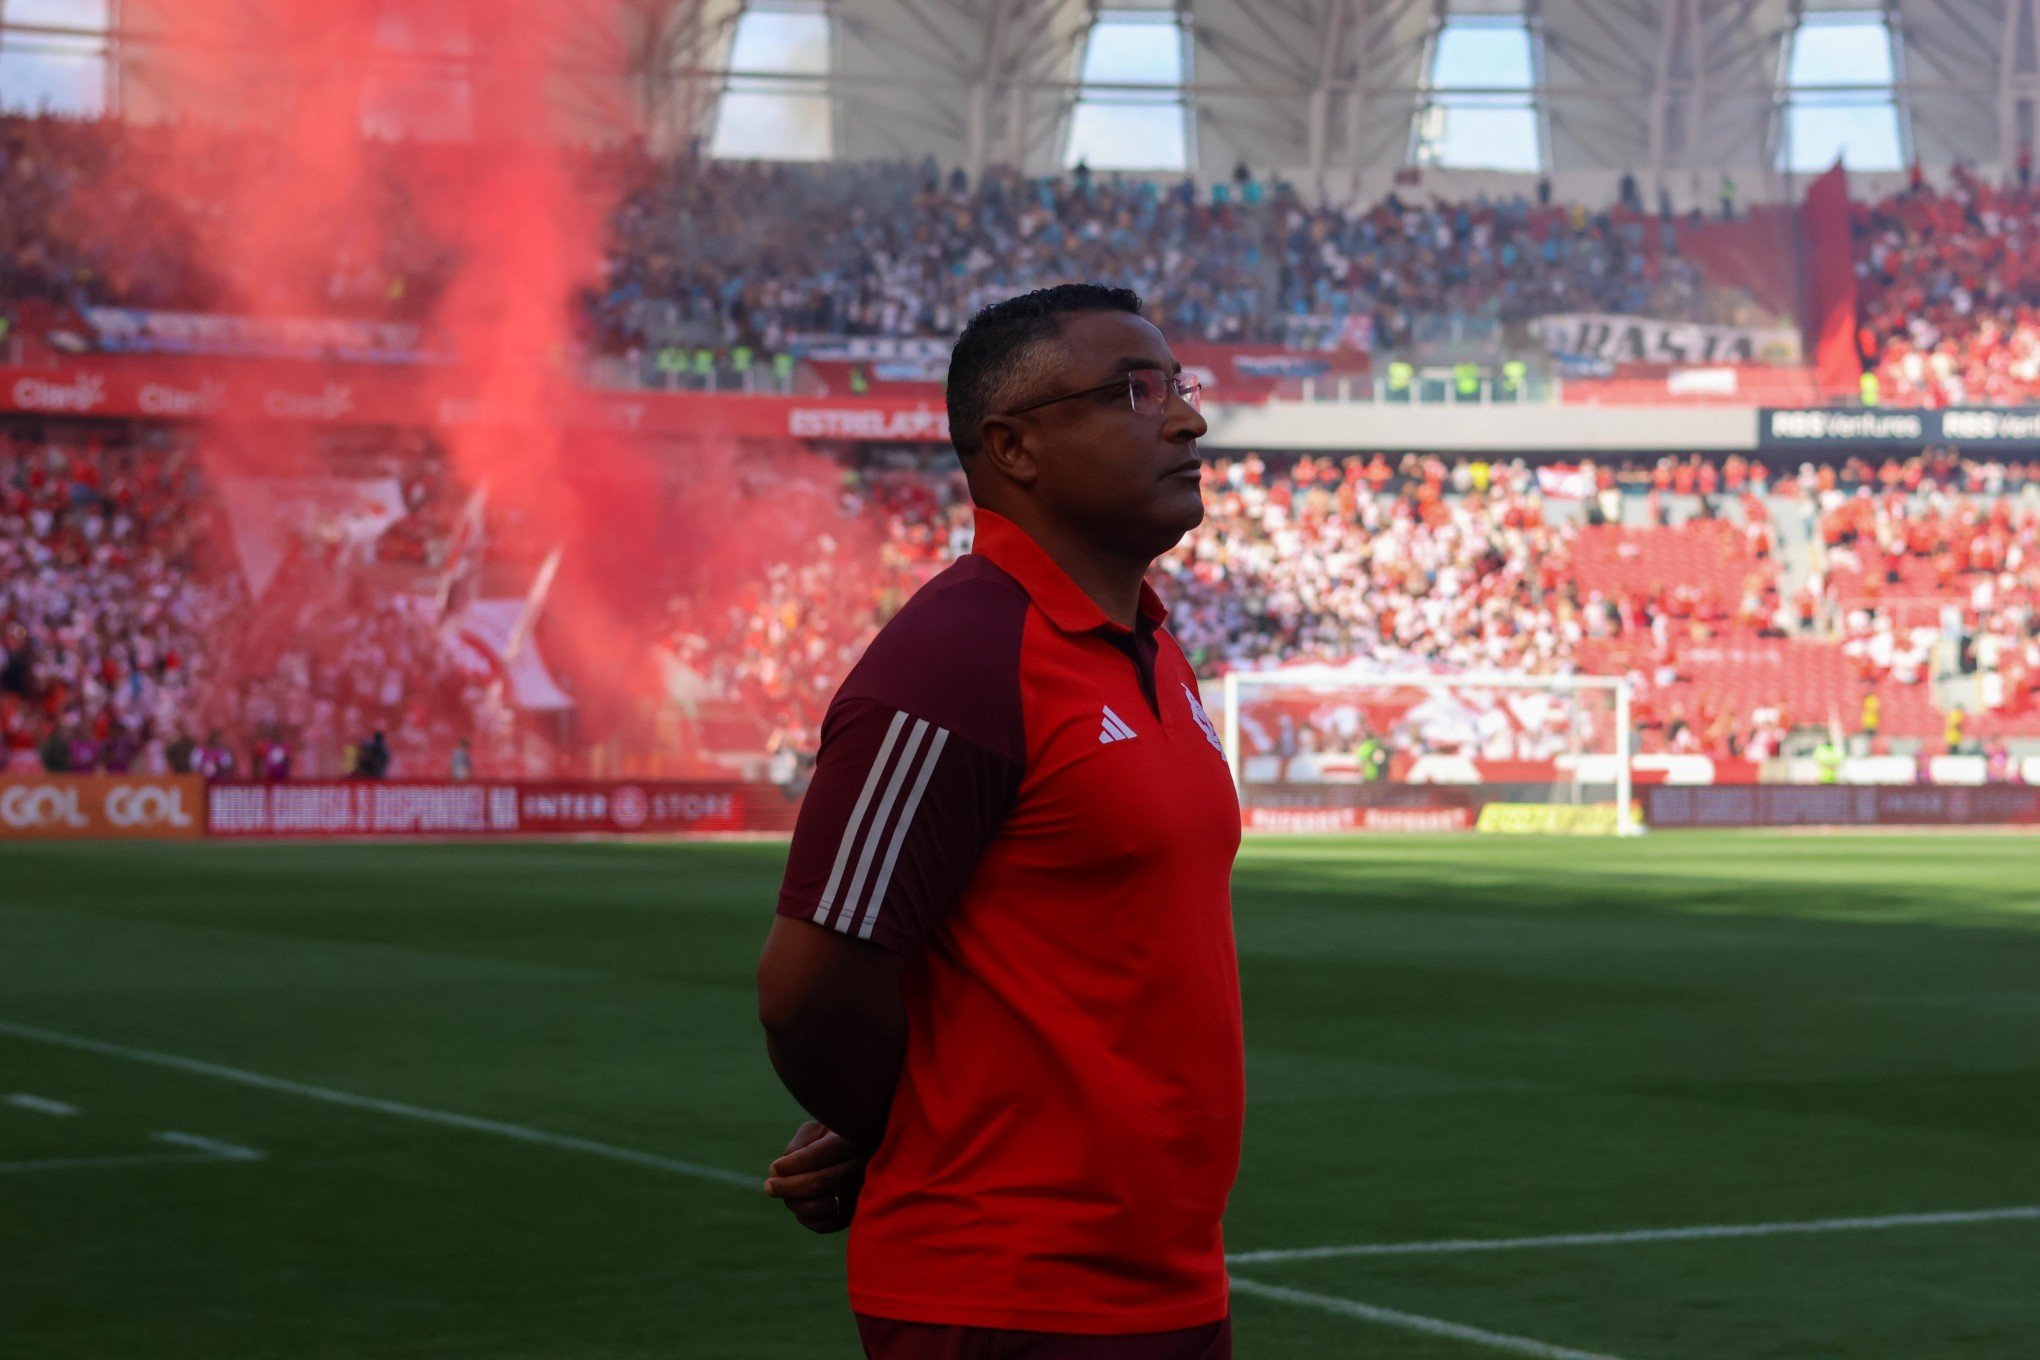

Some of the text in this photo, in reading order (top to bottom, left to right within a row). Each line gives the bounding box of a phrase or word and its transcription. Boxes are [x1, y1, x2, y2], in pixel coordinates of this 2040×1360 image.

[13, 379, 94, 411] Claro
[1, 786, 89, 828] GOL
[104, 785, 192, 827] GOL
[523, 793, 607, 821] INTER
